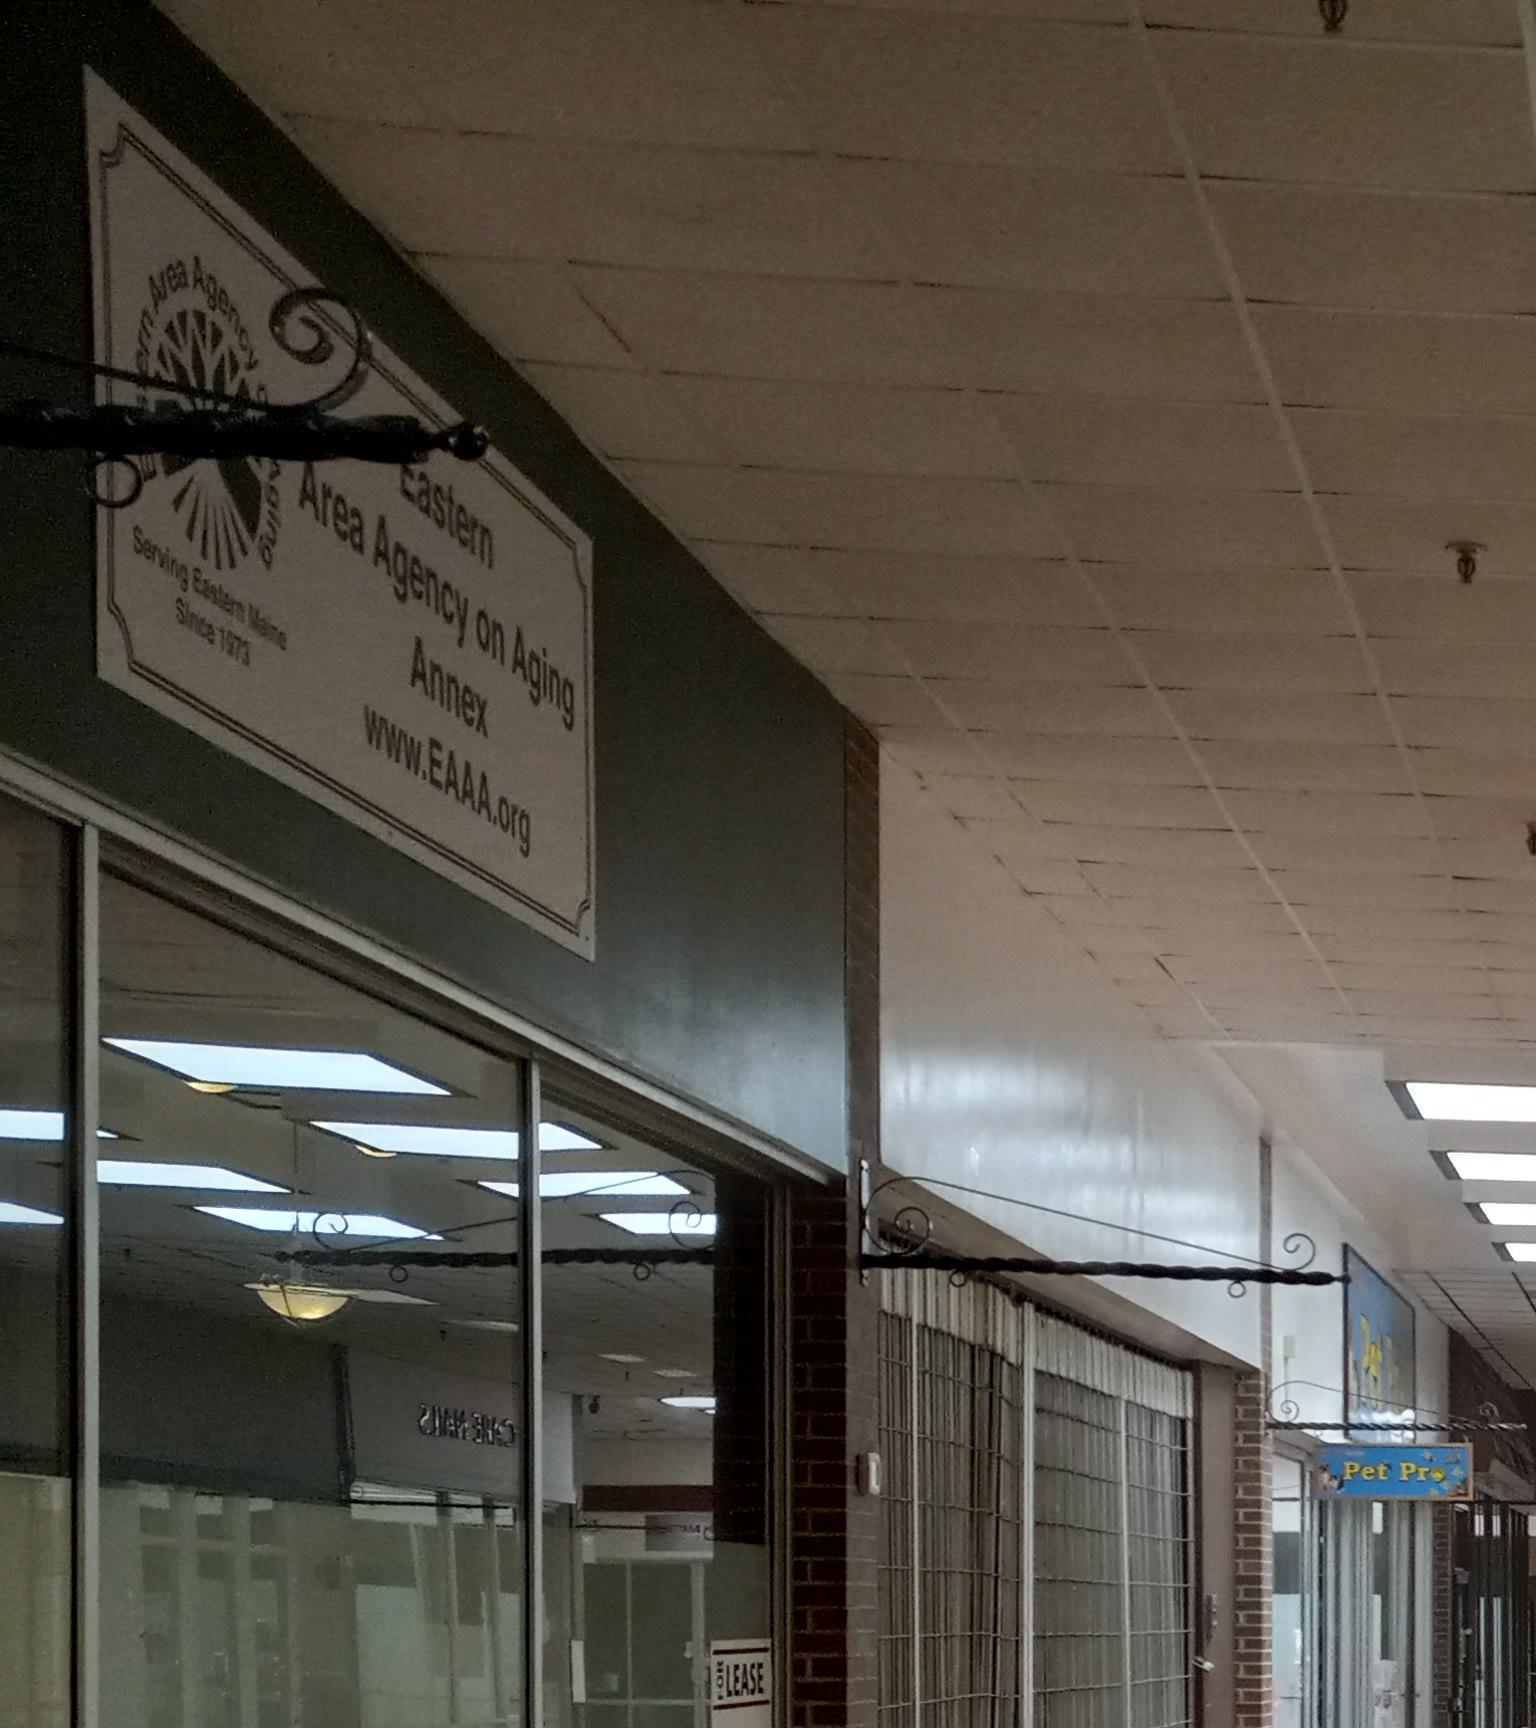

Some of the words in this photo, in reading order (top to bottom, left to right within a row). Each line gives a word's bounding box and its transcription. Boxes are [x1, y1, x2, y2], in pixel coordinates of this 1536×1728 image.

[149, 258, 188, 315] Area
[193, 255, 259, 372] Agency
[400, 464, 495, 570] Eastern
[132, 525, 189, 593] Serving
[191, 566, 246, 624] Eastern
[175, 597, 216, 645] Since
[299, 461, 365, 556] Area
[373, 515, 470, 649] Agency
[475, 607, 506, 666] on
[512, 626, 575, 730] Aging
[410, 636, 490, 737] Annex
[363, 704, 531, 858] www.EAAA.org
[1343, 1460, 1389, 1481] Pet
[1399, 1461, 1447, 1483] Pro
[726, 1662, 764, 1697] LEASE
